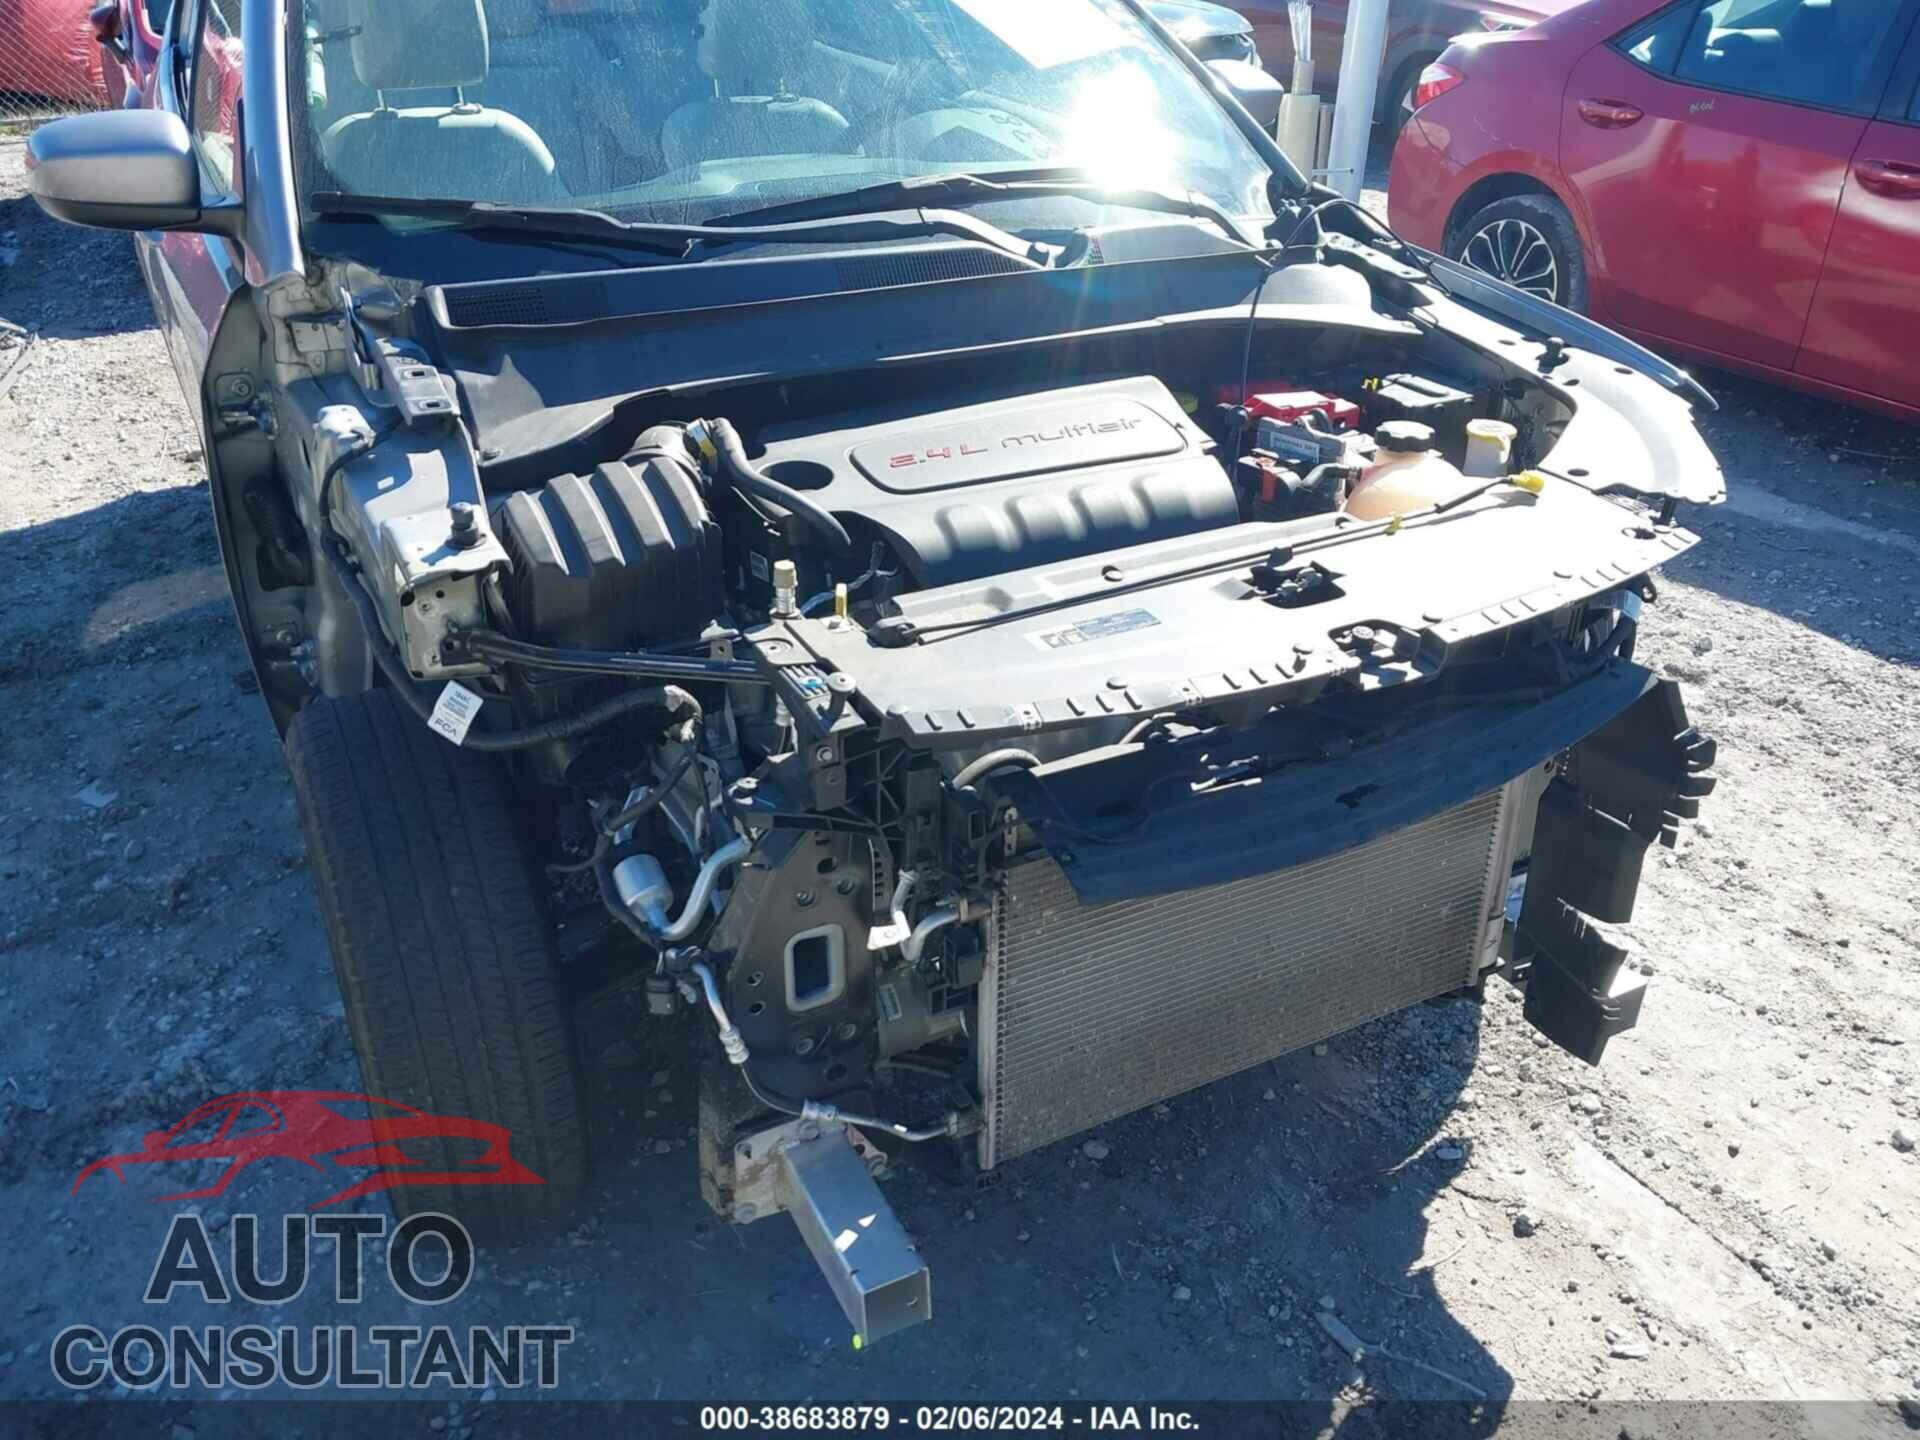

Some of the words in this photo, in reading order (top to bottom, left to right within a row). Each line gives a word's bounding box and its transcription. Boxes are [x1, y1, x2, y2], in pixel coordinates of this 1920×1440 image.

[889, 440, 988, 468] 2.4L
[1000, 416, 1143, 449] multiair
[434, 718, 457, 736] FCA
